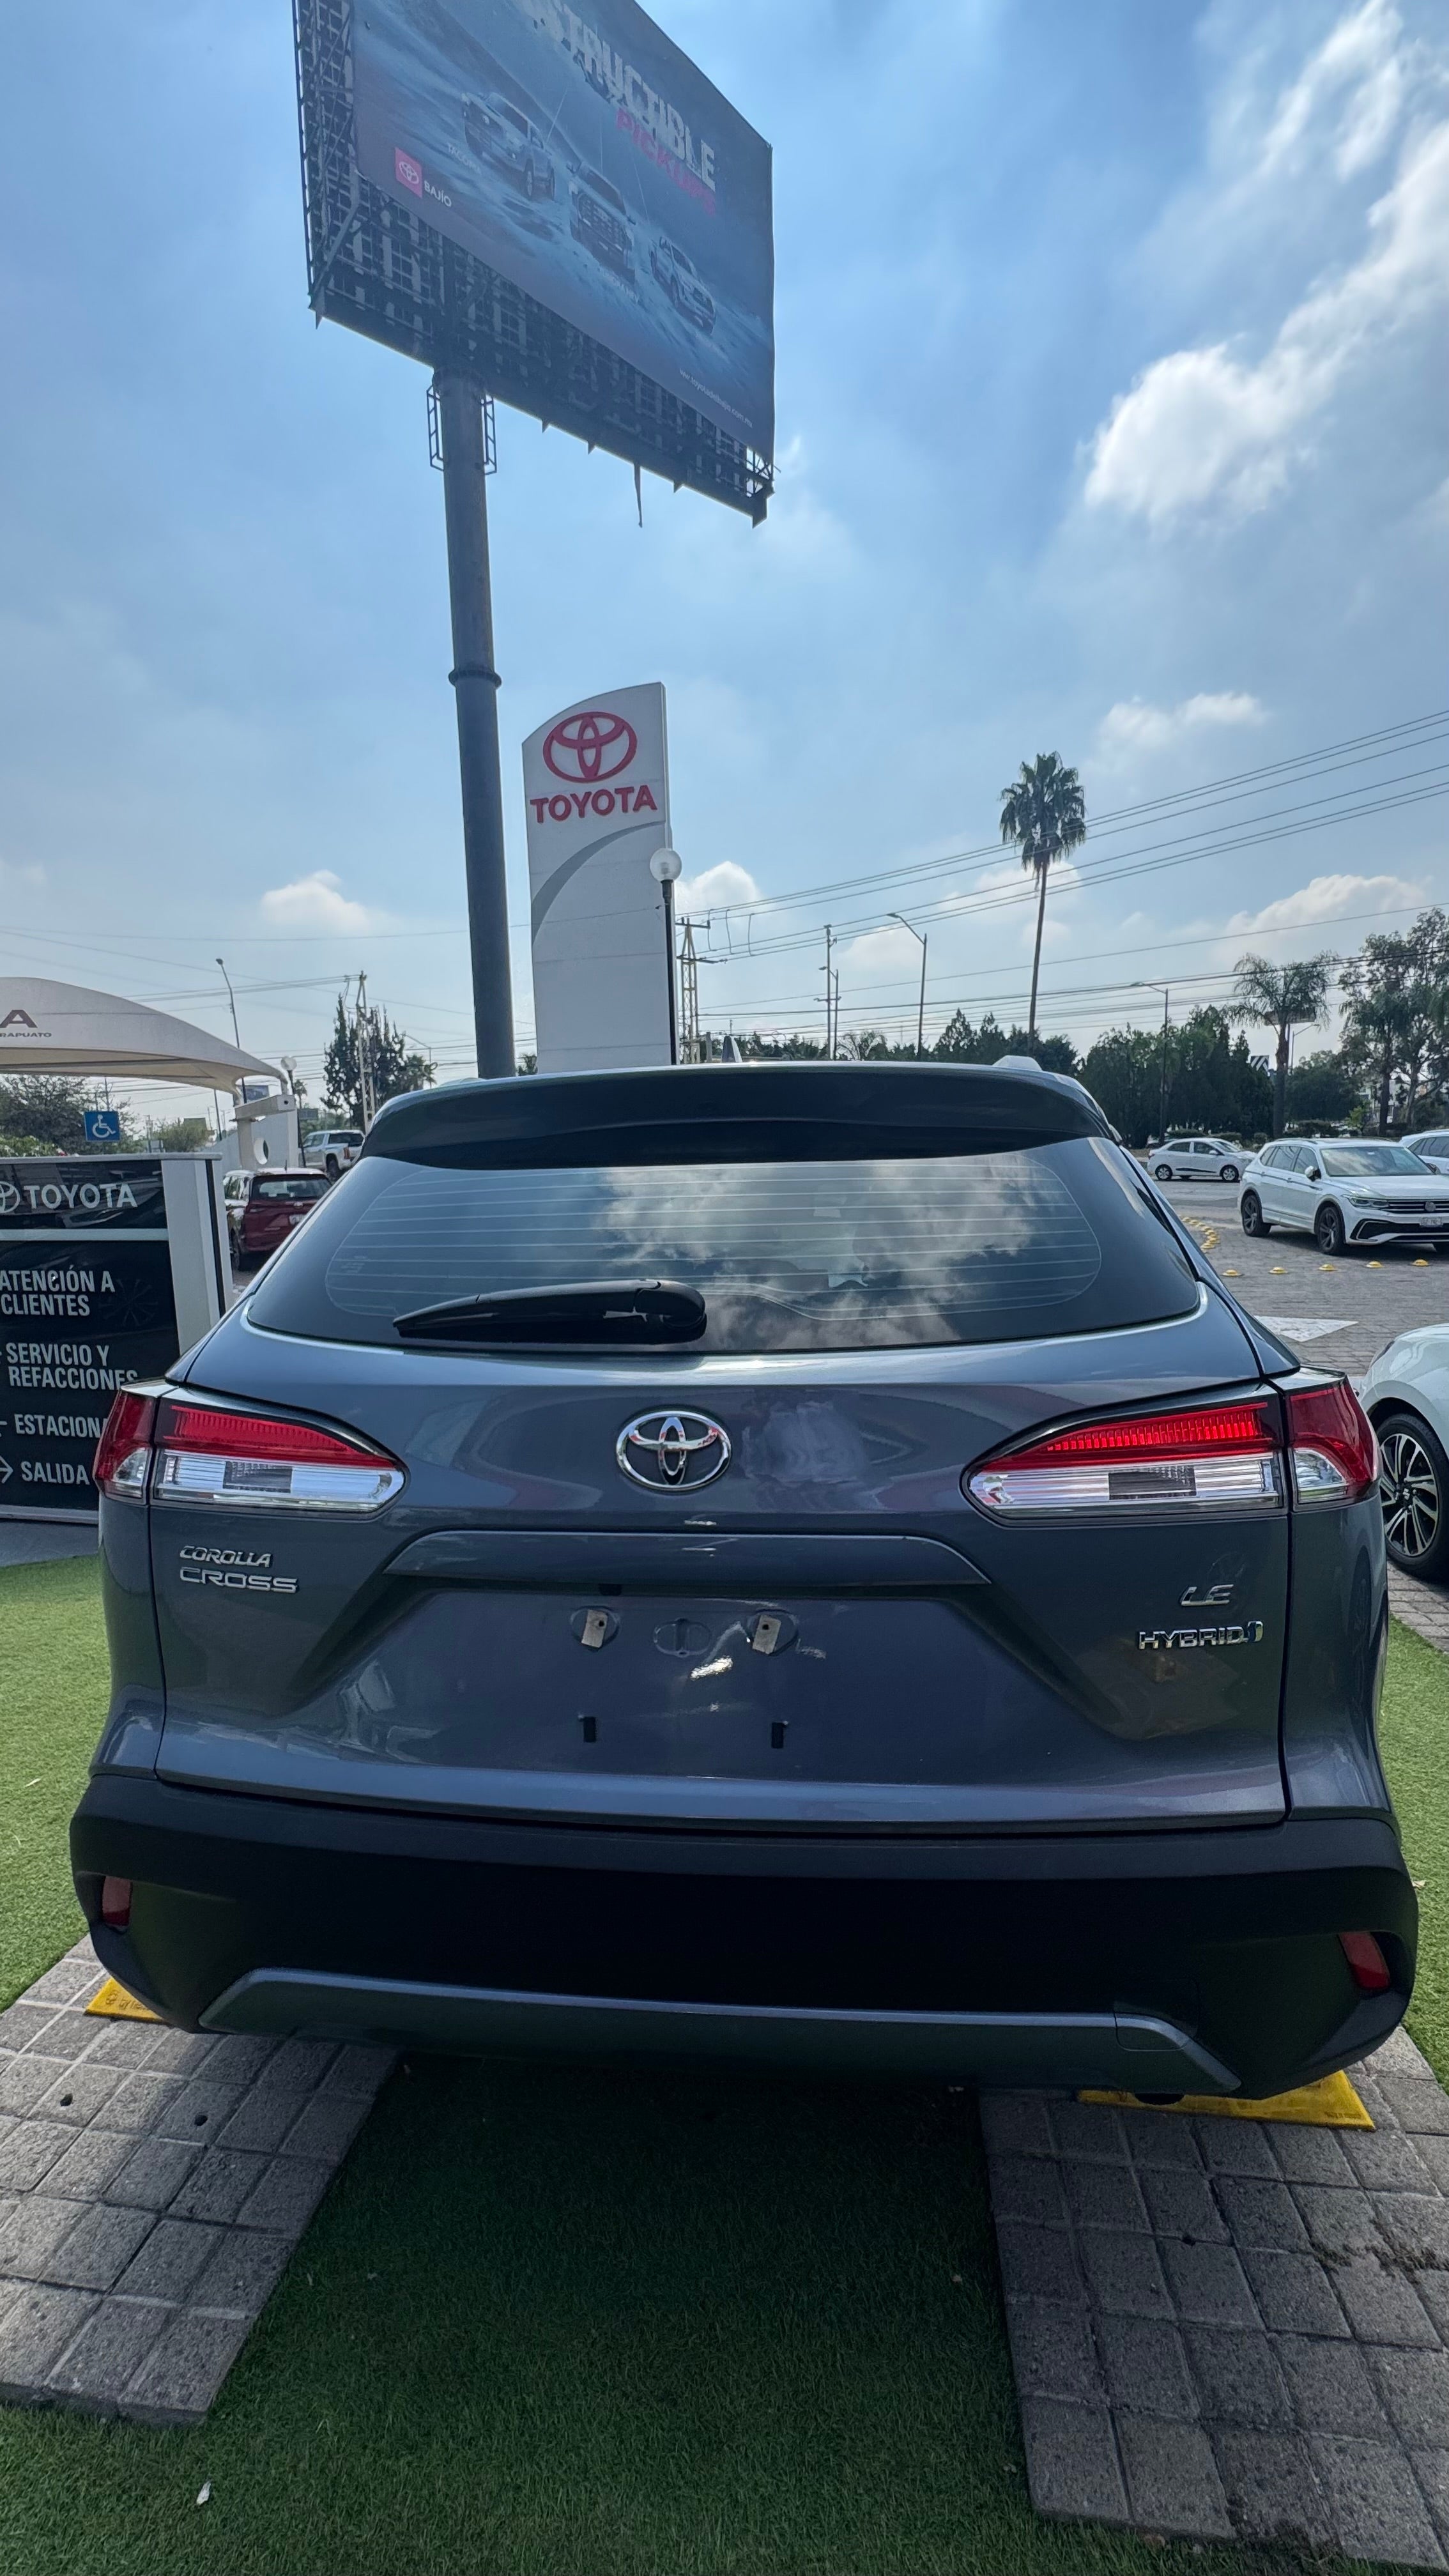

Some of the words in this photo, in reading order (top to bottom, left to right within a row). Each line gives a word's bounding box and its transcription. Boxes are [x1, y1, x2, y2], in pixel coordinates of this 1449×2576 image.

[424, 180, 452, 207] BAJÍO
[530, 785, 657, 824] TOYOTA
[24, 1183, 138, 1209] TOYOTA
[0, 1264, 95, 1292] ATENCIÓN
[100, 1270, 116, 1292] A
[0, 1293, 90, 1316] CLIENTES
[6, 1342, 93, 1366] SERVICIO
[96, 1344, 110, 1367] Y
[20, 1460, 91, 1485] SALIDA
[180, 1545, 272, 1568] COROLLA
[180, 1567, 298, 1593] CROSS
[1180, 1584, 1234, 1606] LE
[1138, 1625, 1248, 1650] HYBRID
